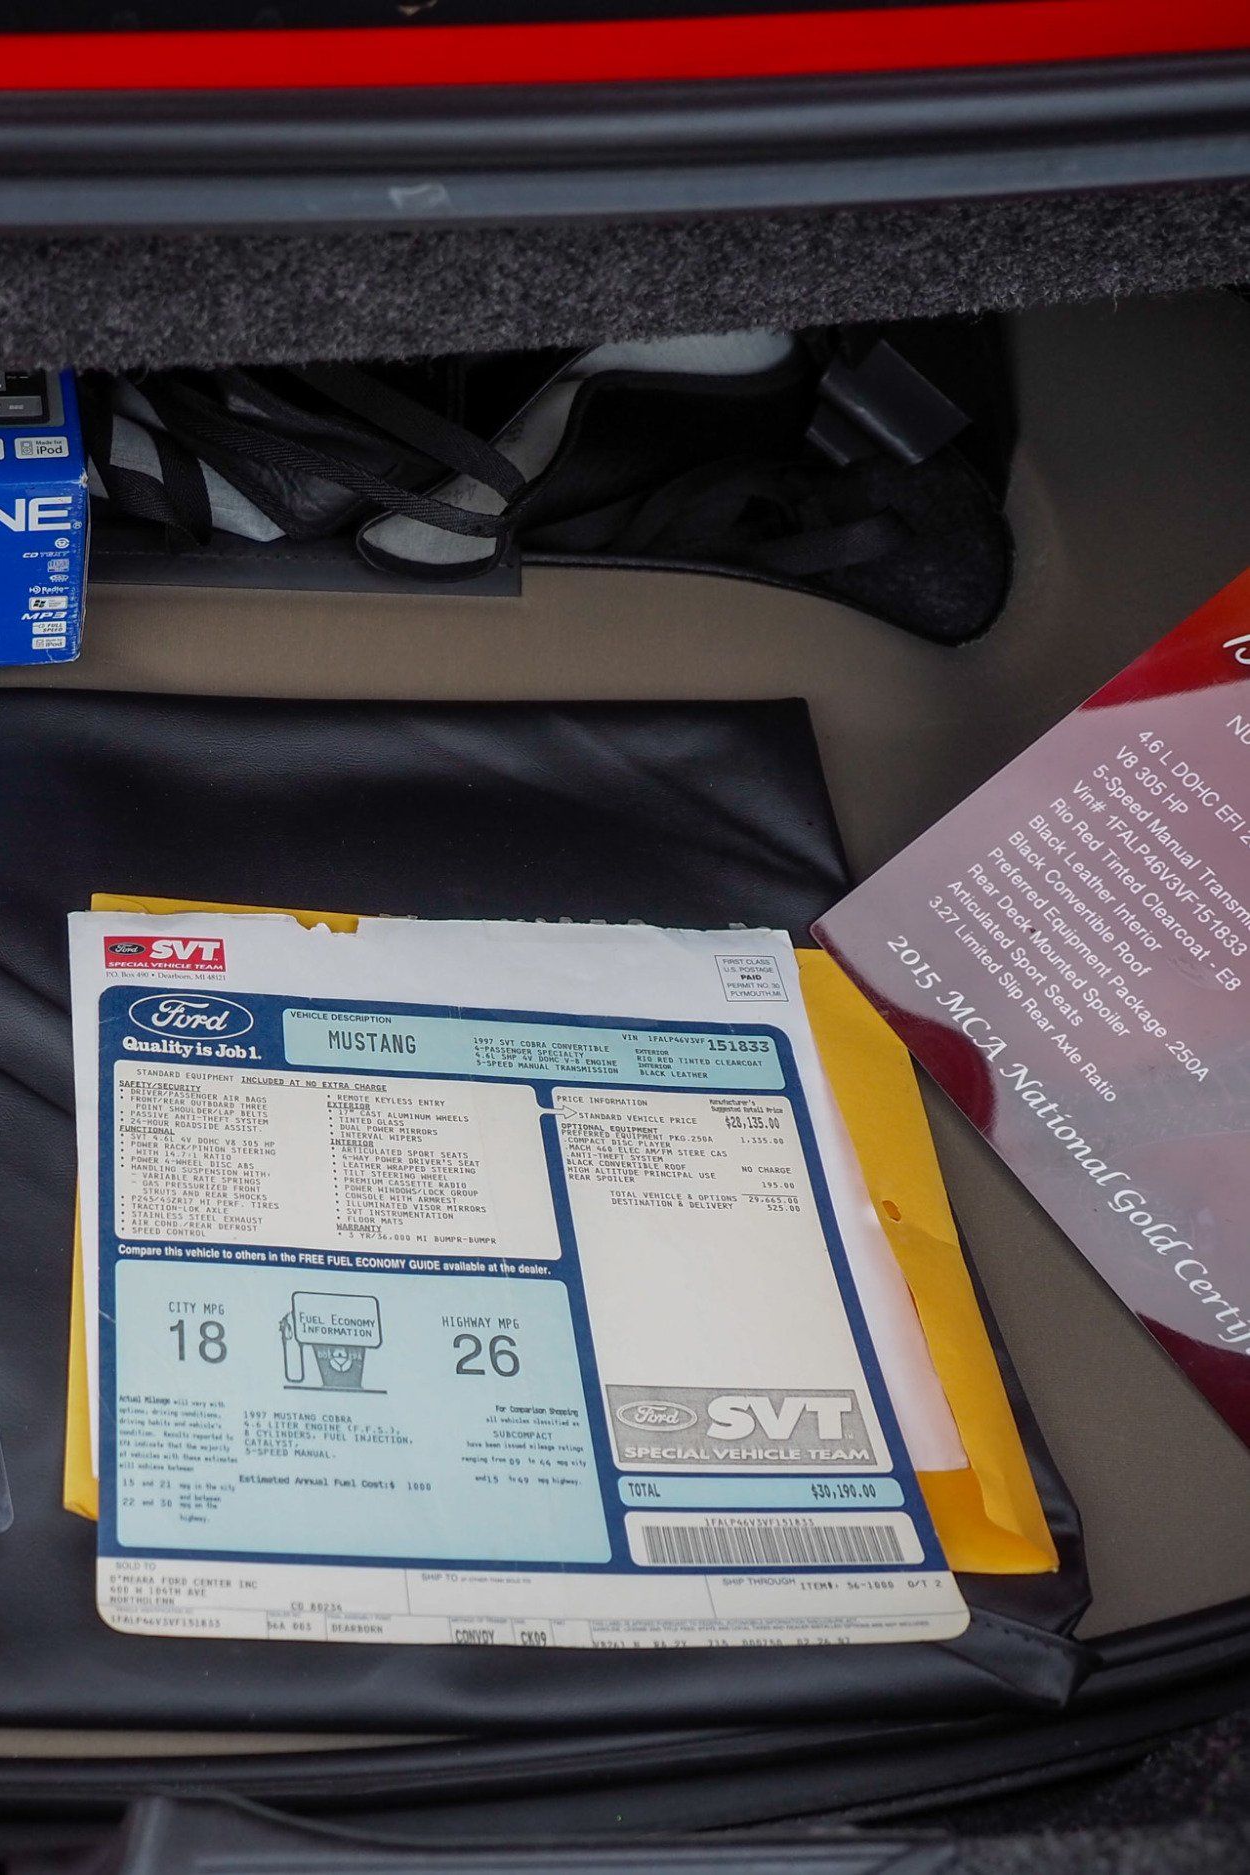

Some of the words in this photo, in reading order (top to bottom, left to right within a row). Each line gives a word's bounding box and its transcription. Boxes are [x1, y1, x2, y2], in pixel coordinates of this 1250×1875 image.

[36, 445, 63, 455] iPod
[21, 611, 67, 620] MP3
[1116, 745, 1139, 769] V8
[1135, 767, 1167, 796] 305
[1162, 793, 1188, 814] HP
[1139, 731, 1164, 754] 4.6
[1160, 750, 1172, 766] L
[1171, 762, 1220, 807] DOHC
[1215, 804, 1246, 833] EFI
[1093, 765, 1154, 822] 5-Speed
[1146, 818, 1203, 871] Manual
[1198, 866, 1250, 931] Transm
[1073, 780, 1107, 813] Vin#
[1105, 815, 1248, 957] 1FALP46V3VF151833
[1028, 814, 1069, 855] Black
[1064, 850, 1116, 905] Leather
[1113, 902, 1163, 953] Interior
[1050, 797, 1074, 823] Rio
[1072, 820, 1104, 852] Red
[1100, 848, 1146, 895] Tinted
[1141, 892, 1211, 961] Clearcoat
[1215, 966, 1241, 992] E8
[1008, 830, 1046, 872] Black
[1044, 869, 1115, 944] Convertible
[1112, 940, 1152, 978] Roof
[115, 944, 139, 953] Ford
[149, 940, 220, 960] SVT
[948, 880, 1014, 950] Articulated
[1010, 947, 1048, 987] Sport
[1044, 984, 1083, 1027] Seats
[967, 863, 999, 895] Rear
[997, 895, 1033, 933] Deck
[1030, 930, 1088, 989] Mounted
[1082, 988, 1130, 1038] Spoiler
[986, 847, 1048, 910] Preferred
[1043, 905, 1113, 979] Equipment
[1107, 974, 1168, 1039] Package
[929, 896, 960, 925] 3.27
[954, 924, 1003, 975] Limited
[998, 972, 1023, 1001] Slip
[1021, 998, 1055, 1034] Rear
[1051, 1033, 1082, 1065] Axle
[1079, 1063, 1117, 1102] Ratio
[152, 1000, 230, 1030] Ford
[290, 1011, 329, 1021] VEHICLE
[331, 1014, 392, 1024] DESCRIPTION
[122, 1036, 193, 1058] Quality
[195, 1043, 212, 1056] is
[215, 1044, 247, 1059] Job
[328, 1030, 417, 1054] MUSTANG
[474, 1037, 493, 1045] 1997
[500, 1039, 515, 1047] SVT
[521, 1040, 547, 1048] COBRA
[551, 1042, 609, 1053] CONVERTIBLE
[707, 1039, 770, 1052] 151833
[476, 1060, 513, 1068] 5-SPEED
[518, 1062, 550, 1070] MANUAL
[555, 1064, 619, 1074] TRANSMISSION
[640, 1069, 665, 1077] BLACK
[672, 1071, 708, 1079] LEATHER
[715, 1059, 763, 1067] CLEARCOAT
[137, 1069, 180, 1078] STANDARD
[186, 1072, 234, 1082] EQUIPMENT
[241, 1076, 285, 1086] INCLUDED
[322, 1081, 350, 1090] EXTRA
[354, 1083, 388, 1092] CHARGE
[556, 1095, 585, 1104] PRICE
[589, 1096, 648, 1106] INFORMATION
[887, 935, 943, 992] 2015
[935, 990, 1008, 1063] MCA
[999, 1063, 1131, 1188] National
[1107, 1187, 1194, 1257] Gold
[579, 1112, 622, 1121] STANDARD
[627, 1115, 665, 1124] VEHICLE
[670, 1117, 697, 1125] PRICE
[725, 1116, 780, 1130] $28,135.00
[118, 1244, 162, 1258] Compare
[164, 1246, 183, 1256] this
[185, 1247, 220, 1258] vehicle
[222, 1250, 233, 1259] to
[235, 1250, 266, 1261] others
[268, 1252, 279, 1262] in
[280, 1252, 296, 1262] the
[299, 1253, 325, 1265] FREE
[327, 1255, 353, 1266] FUEL
[355, 1257, 406, 1268] ECONOMY
[408, 1259, 441, 1270] GUIDE
[443, 1261, 486, 1272] available
[488, 1263, 498, 1273] at
[500, 1263, 516, 1273] the
[518, 1264, 551, 1275] dealer.
[168, 1301, 197, 1314] CITY
[204, 1304, 225, 1316] MPG
[298, 1312, 325, 1325] FUEL
[331, 1315, 376, 1328] ECONOMY
[301, 1325, 373, 1338] INFORMATION
[441, 1315, 491, 1330] HIGHWAY
[497, 1318, 520, 1331] MPG
[169, 1319, 229, 1365] 18
[452, 1333, 521, 1378] 26
[634, 1405, 680, 1425] Ford
[707, 1395, 852, 1440] SVT
[624, 1446, 711, 1460] SPECIAL
[712, 1448, 802, 1461] VEHICLE
[808, 1448, 870, 1461] TEAM
[628, 1482, 661, 1498] TOTAL
[810, 1484, 877, 1499] $30,190.00
